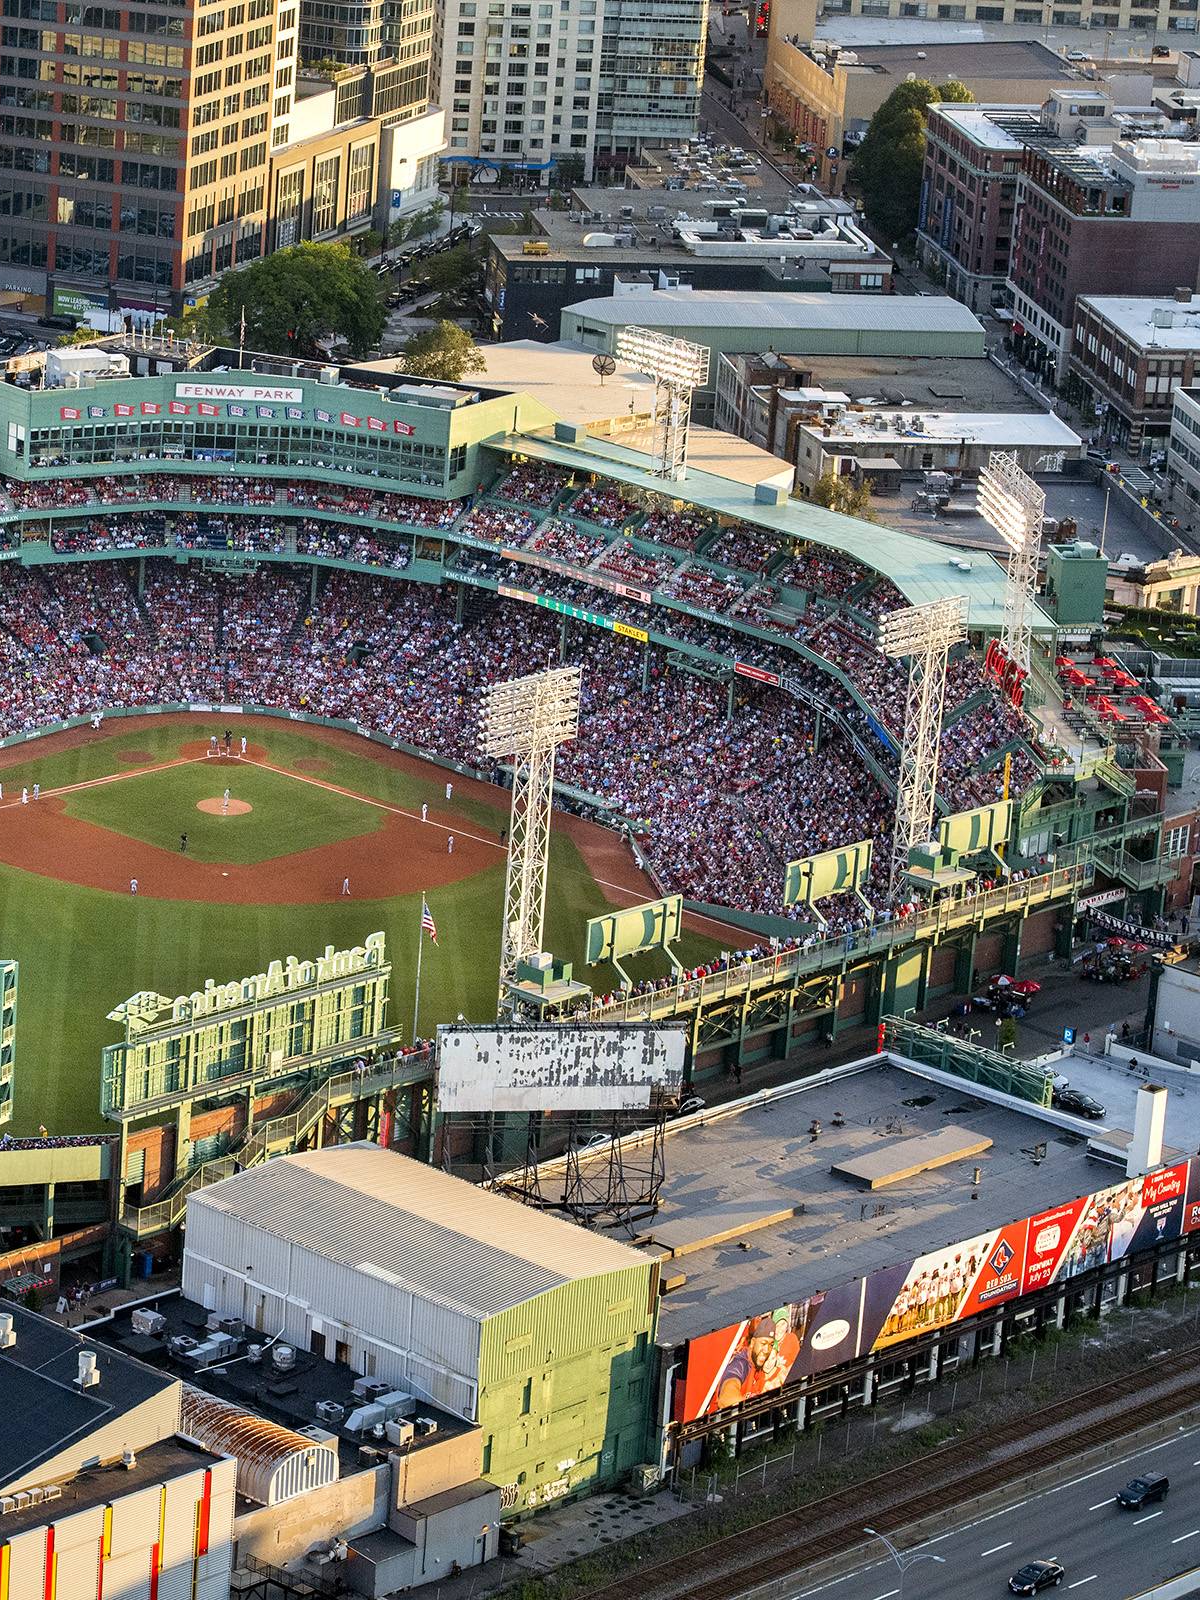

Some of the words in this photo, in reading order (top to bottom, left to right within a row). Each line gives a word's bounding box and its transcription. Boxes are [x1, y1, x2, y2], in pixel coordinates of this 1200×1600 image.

[5, 283, 32, 294] PARKING
[184, 386, 245, 398] FENWAY
[254, 389, 294, 400] PARK
[617, 625, 645, 639] STANLEY
[1089, 907, 1138, 935] FENWAY
[1140, 928, 1174, 943] PARK
[1144, 1186, 1157, 1202] My
[1157, 1180, 1181, 1195] Country
[1028, 1257, 1054, 1273] FENWAY
[1042, 1267, 1051, 1278] 23
[985, 1278, 999, 1290] RED
[1000, 1272, 1013, 1284] SOX
[979, 1281, 1017, 1301] FOUNDATION
